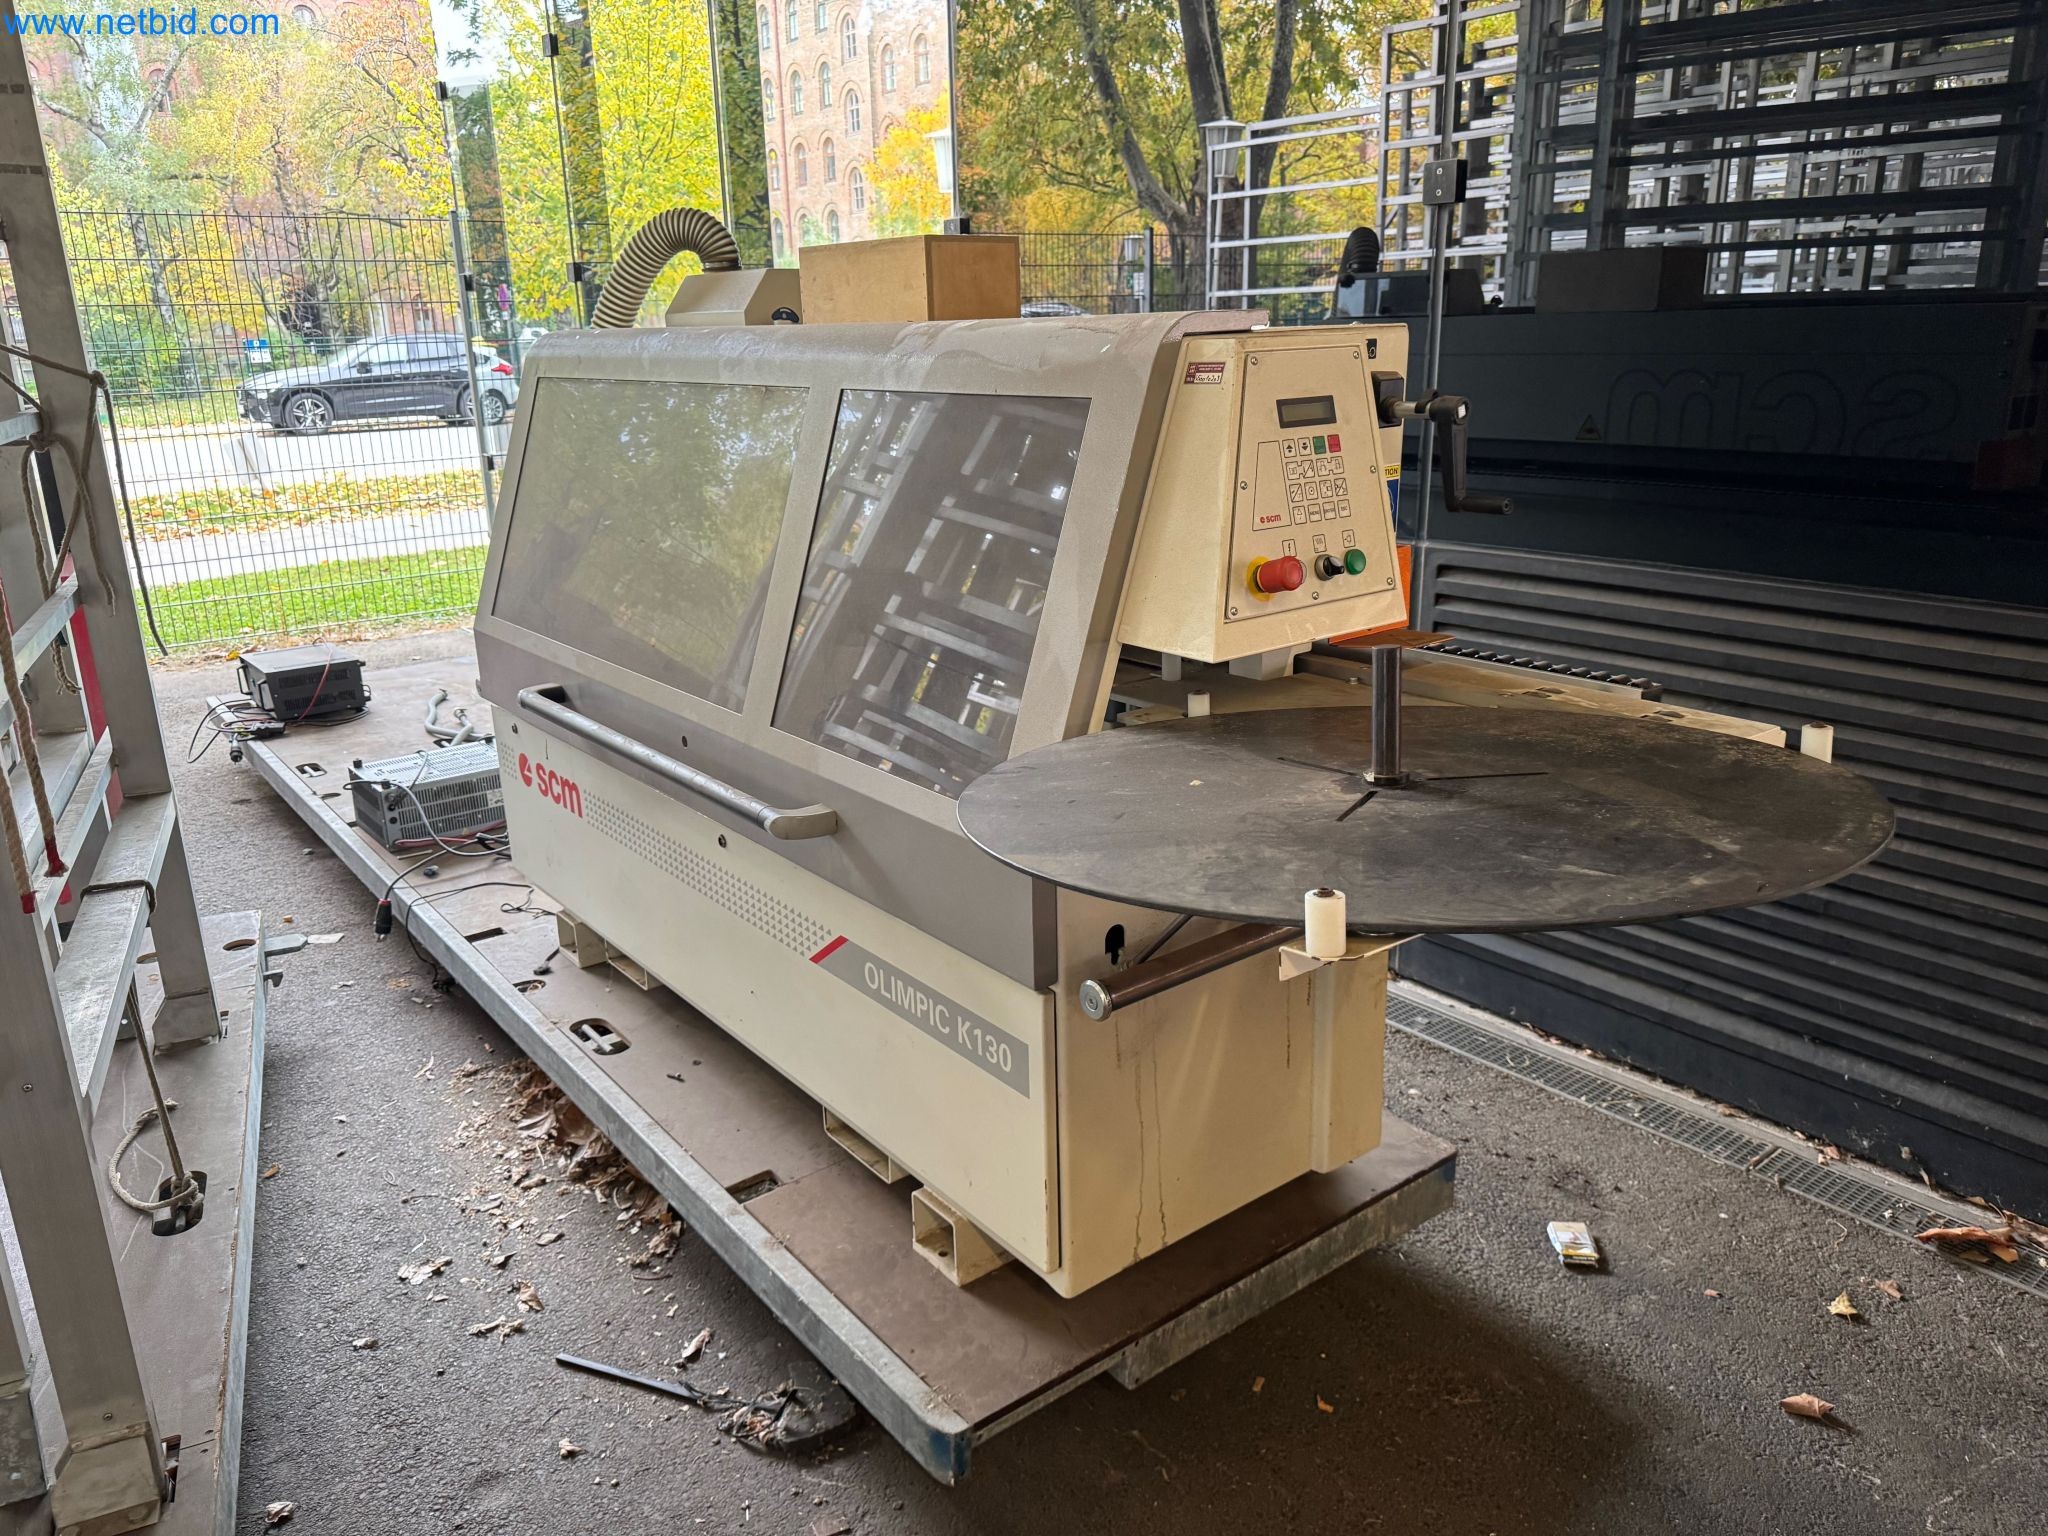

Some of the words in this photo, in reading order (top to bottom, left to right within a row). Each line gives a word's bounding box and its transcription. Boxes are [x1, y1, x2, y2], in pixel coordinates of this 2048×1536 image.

[1266, 514, 1281, 523] scm
[536, 762, 583, 819] scm
[864, 962, 950, 1034] OLIMPIC
[957, 1015, 1012, 1073] K130
